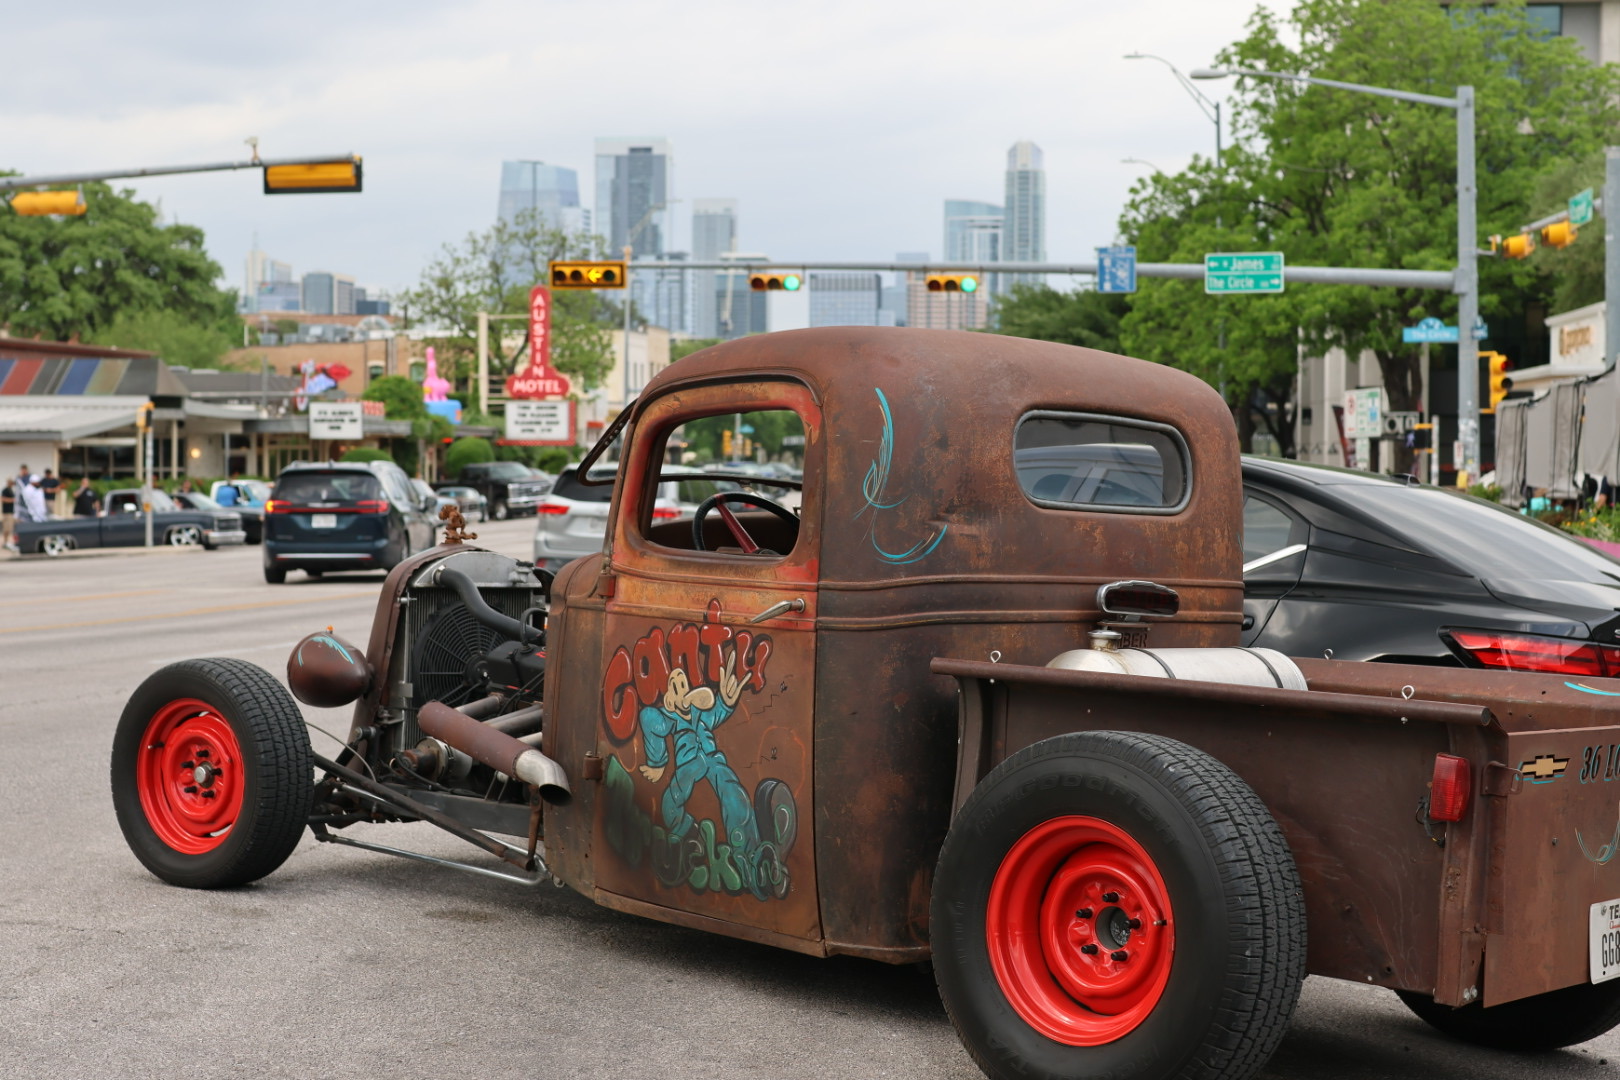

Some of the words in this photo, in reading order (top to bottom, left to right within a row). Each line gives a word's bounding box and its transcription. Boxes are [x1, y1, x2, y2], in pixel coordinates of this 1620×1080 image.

[1230, 256, 1264, 271] James
[1208, 276, 1225, 288] The
[1227, 276, 1255, 288] Circle
[532, 294, 546, 378] AUSTIN
[512, 380, 562, 393] MOTEL
[1580, 745, 1602, 784] 36
[1610, 904, 1620, 920] TE
